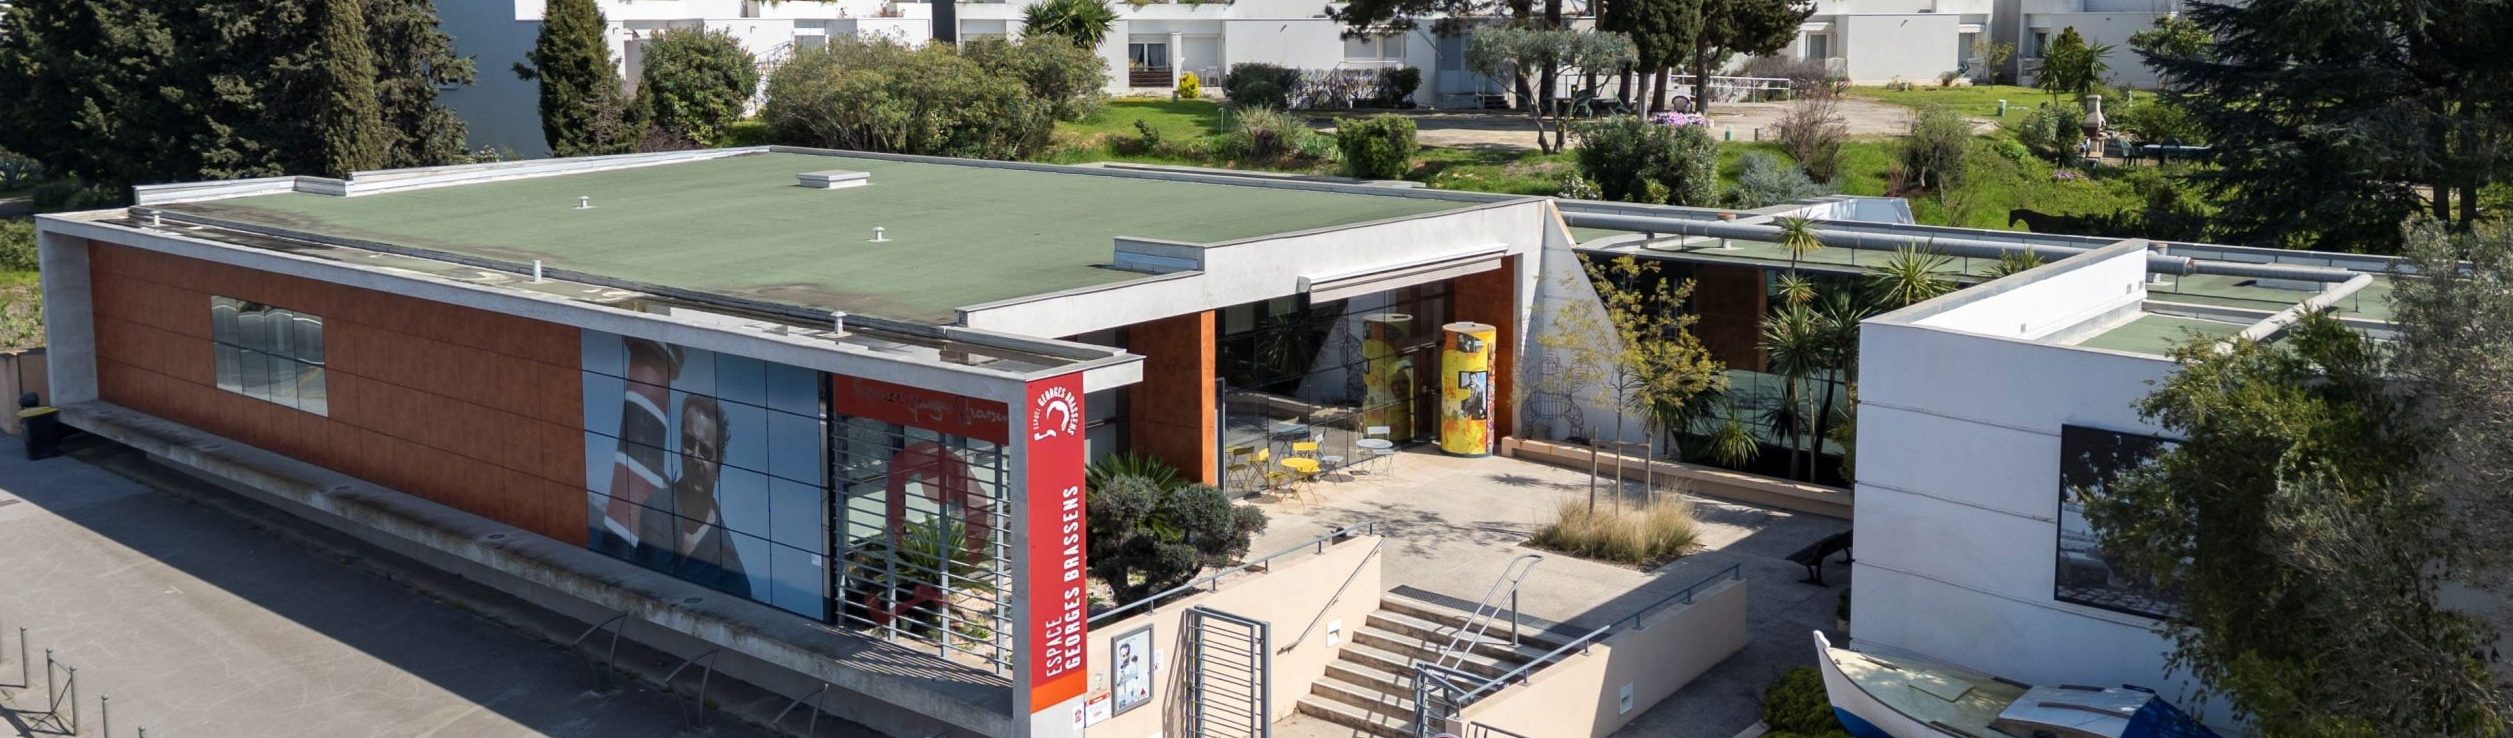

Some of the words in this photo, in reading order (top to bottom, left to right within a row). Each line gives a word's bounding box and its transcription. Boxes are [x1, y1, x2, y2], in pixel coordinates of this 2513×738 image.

[1037, 386, 1066, 407] GEORGES
[1064, 391, 1079, 436] BRASSENS
[1063, 485, 1080, 582] BRASSENS
[1046, 616, 1063, 678] ESPACE
[1064, 586, 1081, 670] GEORGES
